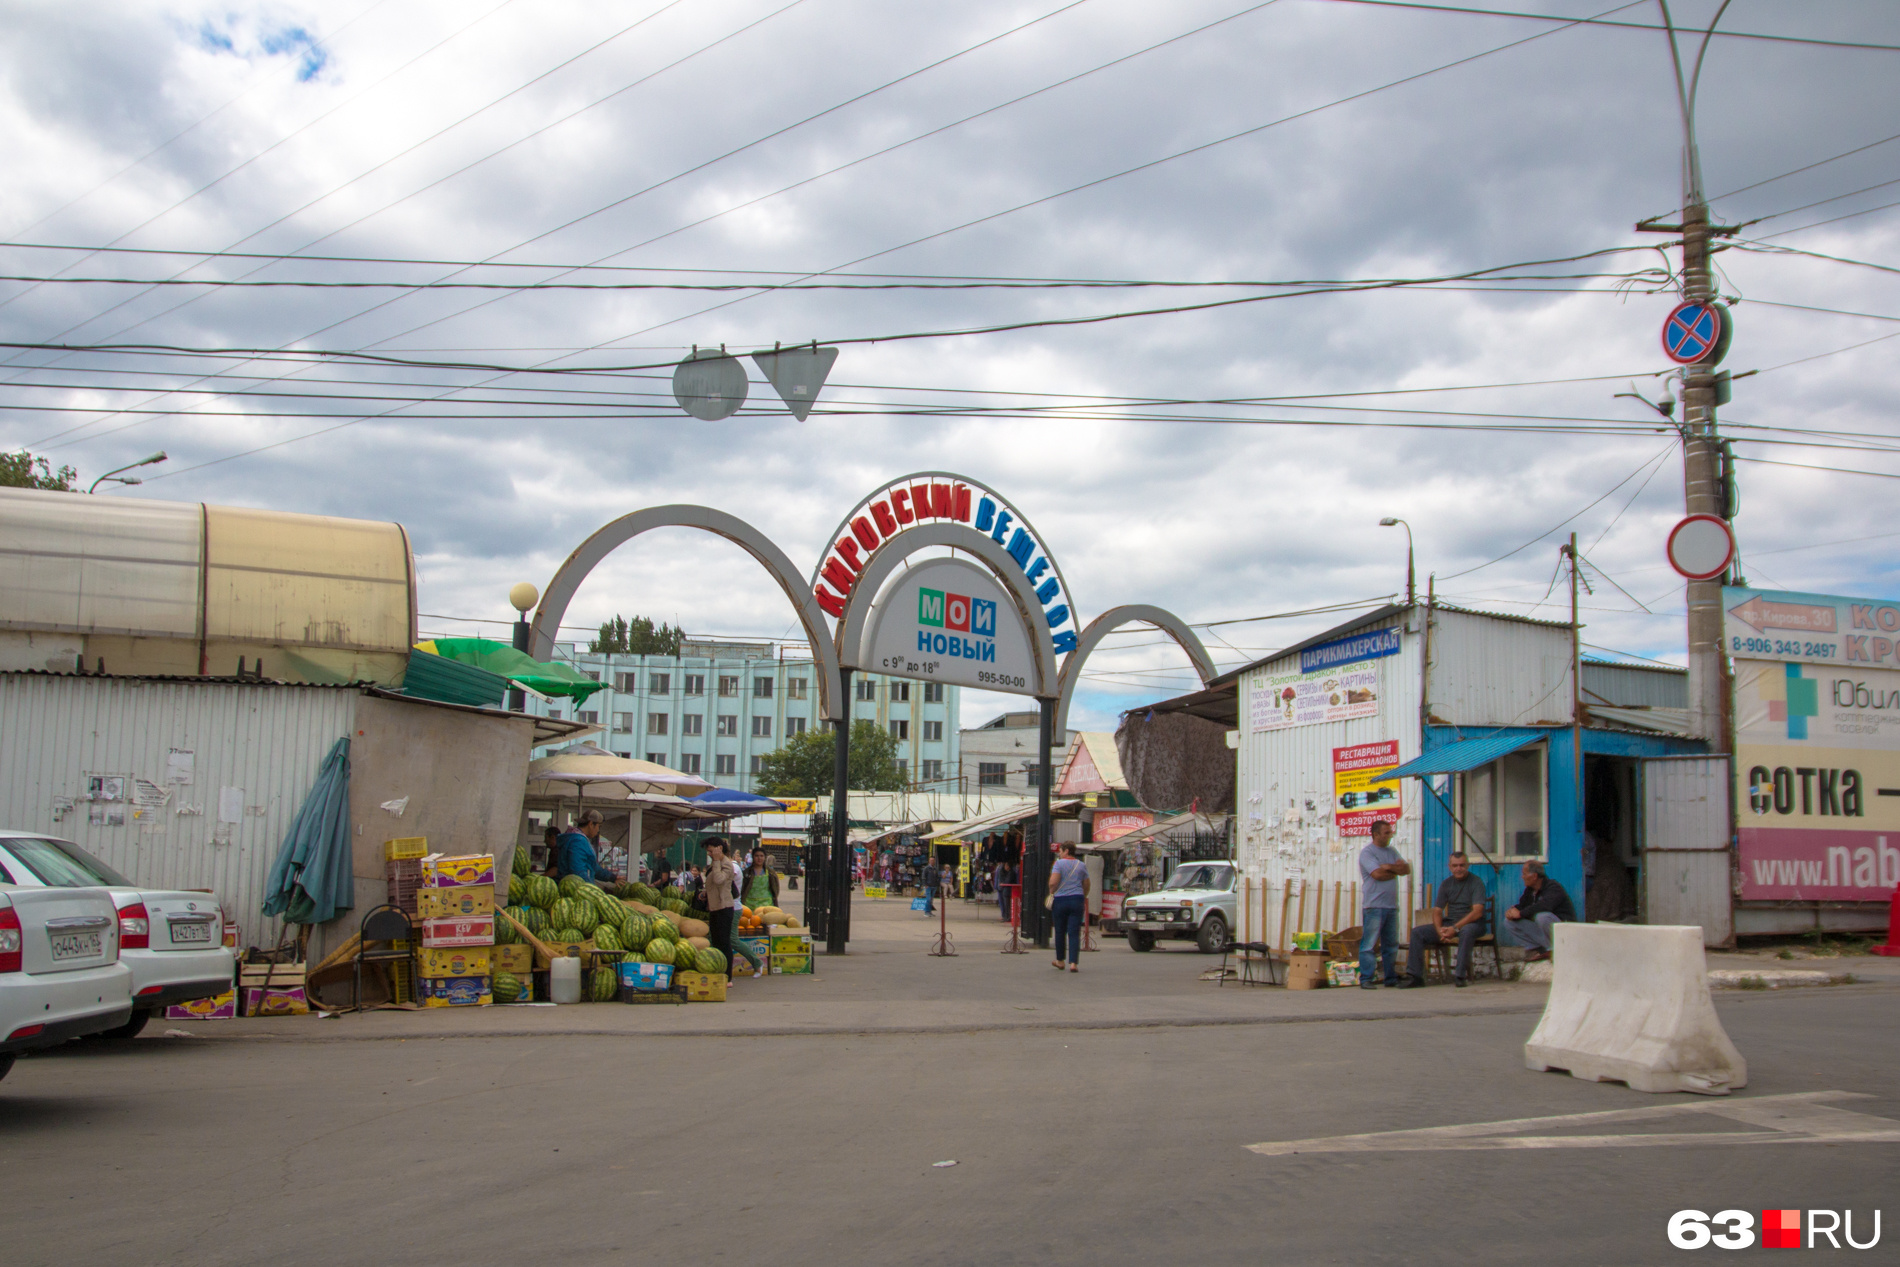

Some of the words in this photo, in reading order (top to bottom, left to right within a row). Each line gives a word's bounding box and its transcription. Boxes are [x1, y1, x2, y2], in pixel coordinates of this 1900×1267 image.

[815, 483, 971, 618] КИРОВСКИЙ
[975, 497, 1077, 655] ВЕЩЕВОЙ
[921, 594, 993, 631] МОЙ
[1812, 608, 1832, 626] 30
[918, 630, 996, 663] НОВЫЙ
[1303, 633, 1399, 668] ПАРИКМАХЕРСКАЯ
[1733, 636, 1772, 653] 8-906
[1775, 639, 1801, 655] 343
[1805, 641, 1837, 658] 2497
[1846, 634, 1900, 663] КР
[907, 662, 919, 672] до
[1253, 679, 1264, 689] ТЦ
[1343, 662, 1368, 673] место
[1370, 659, 1376, 669] 5
[978, 671, 1025, 688] 995-50-00
[1341, 672, 1377, 688] КАРТИНЫ
[1257, 700, 1271, 709] ВАЗЫ
[1339, 744, 1392, 760] РЕСТАВРАЦИЯ
[1335, 754, 1398, 770] ПНЕВМОБАЛЛОНОВ
[1099, 815, 1120, 829] СВЕЖАЯ
[1122, 815, 1148, 829] ВЫПЕЧКА
